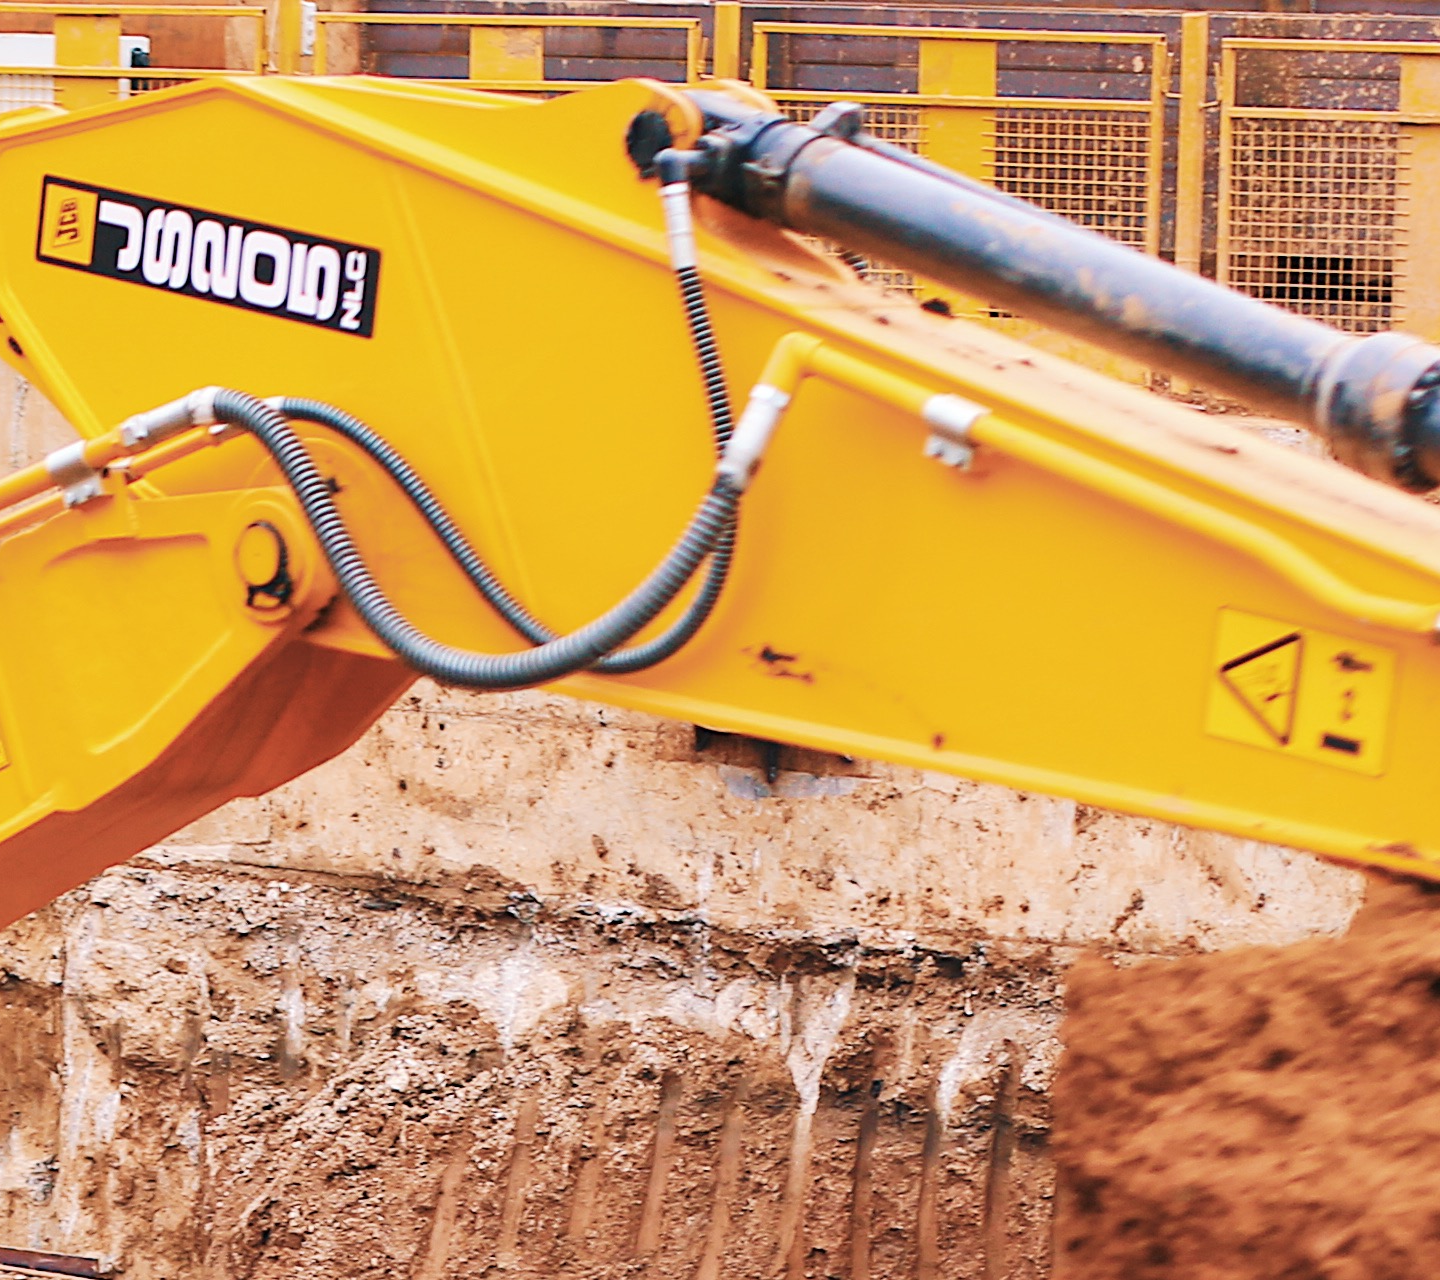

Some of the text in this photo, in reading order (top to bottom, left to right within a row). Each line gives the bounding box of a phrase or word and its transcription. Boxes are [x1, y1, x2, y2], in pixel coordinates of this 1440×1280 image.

[55, 201, 78, 240] JCB
[97, 199, 367, 331] JS205 NLC
